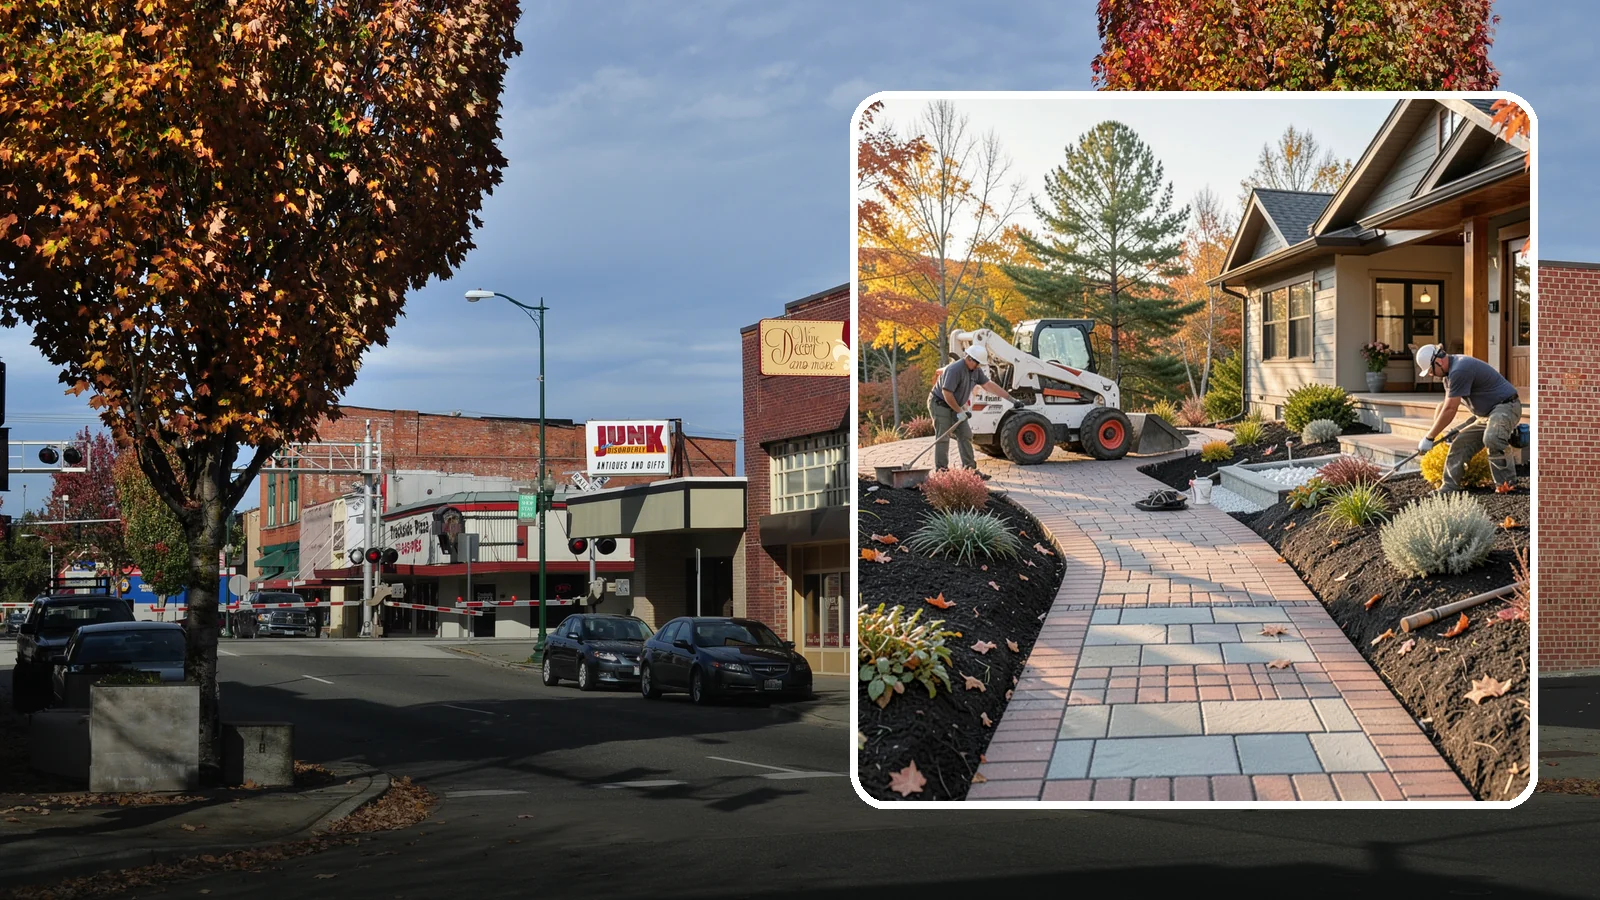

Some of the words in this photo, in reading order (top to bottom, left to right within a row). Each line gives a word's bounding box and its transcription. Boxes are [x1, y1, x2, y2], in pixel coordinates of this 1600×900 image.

[791, 325, 823, 345] Wine
[596, 425, 665, 457] JUNK
[597, 461, 628, 470] ANTIQUES
[631, 461, 643, 469] AND
[647, 461, 665, 469] GIFTS
[352, 498, 364, 510] CRO
[414, 519, 429, 535] Pizza
